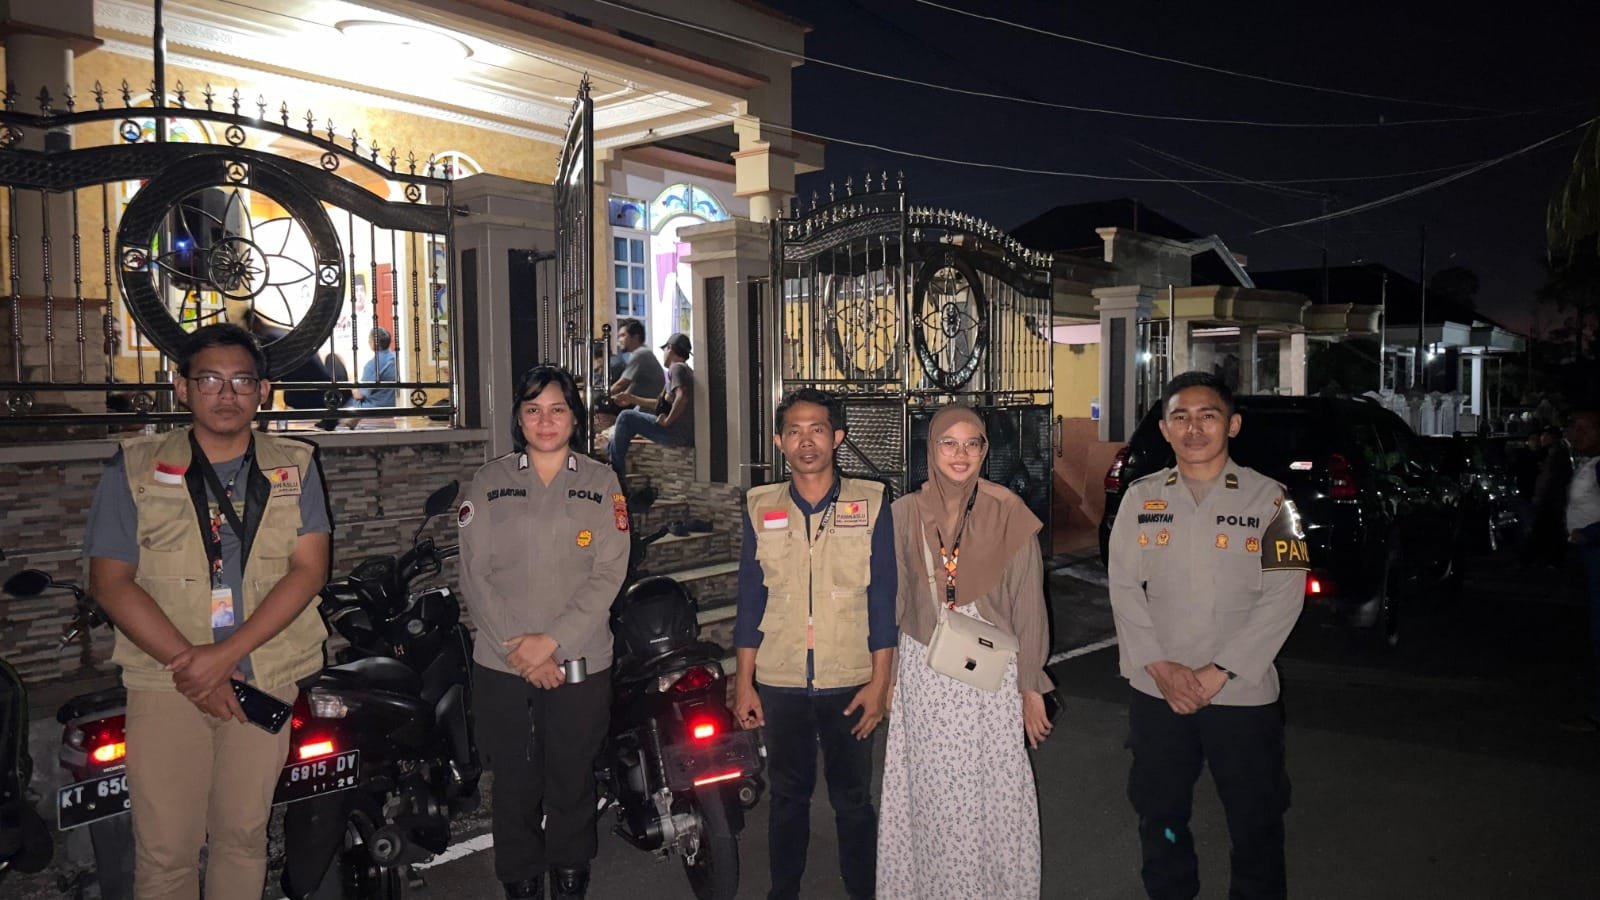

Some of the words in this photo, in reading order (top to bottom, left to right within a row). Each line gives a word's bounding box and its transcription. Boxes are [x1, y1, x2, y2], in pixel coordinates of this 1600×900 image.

[568, 489, 602, 504] POLRI
[1217, 515, 1260, 528] POLRI
[291, 760, 327, 782] 6915
[336, 754, 356, 773] DV
[62, 786, 85, 808] KT
